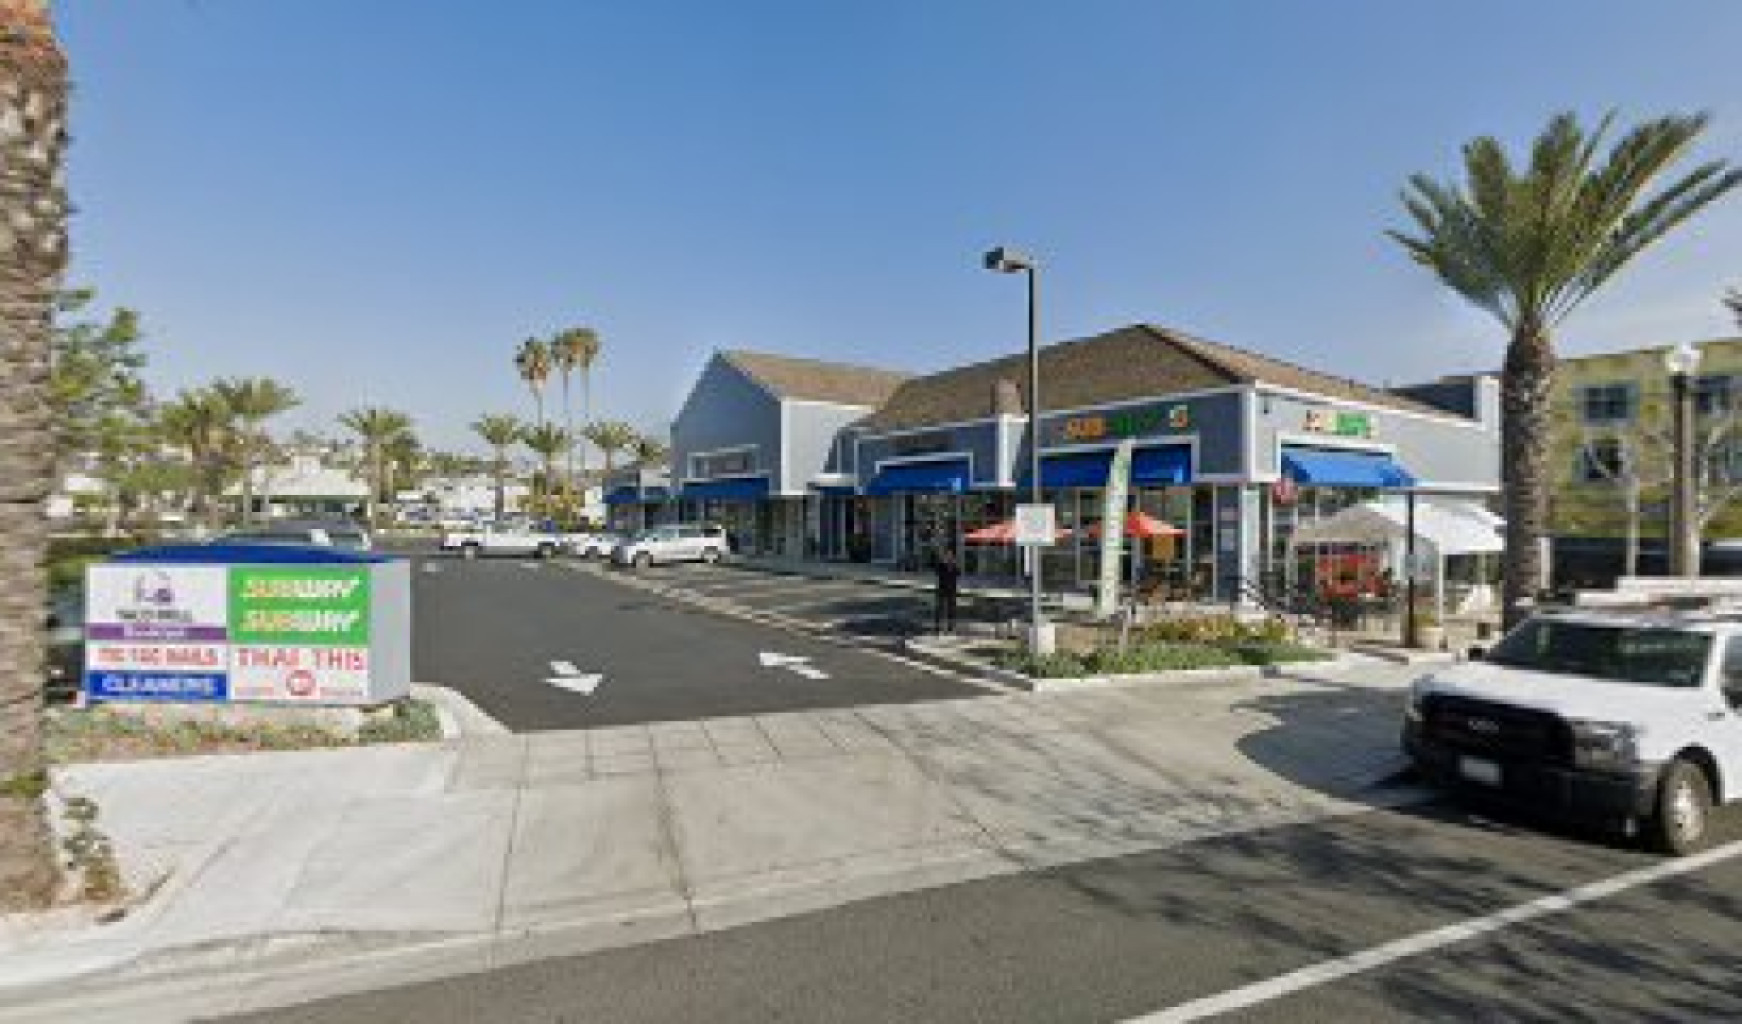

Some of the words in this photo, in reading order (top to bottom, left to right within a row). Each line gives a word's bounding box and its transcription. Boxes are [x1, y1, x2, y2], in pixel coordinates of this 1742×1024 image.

[241, 576, 361, 600] SUBWAY
[241, 608, 361, 632] SUBWAY
[238, 648, 300, 667] THAI
[313, 648, 366, 672] THIS
[102, 675, 214, 695] CLEANERS
